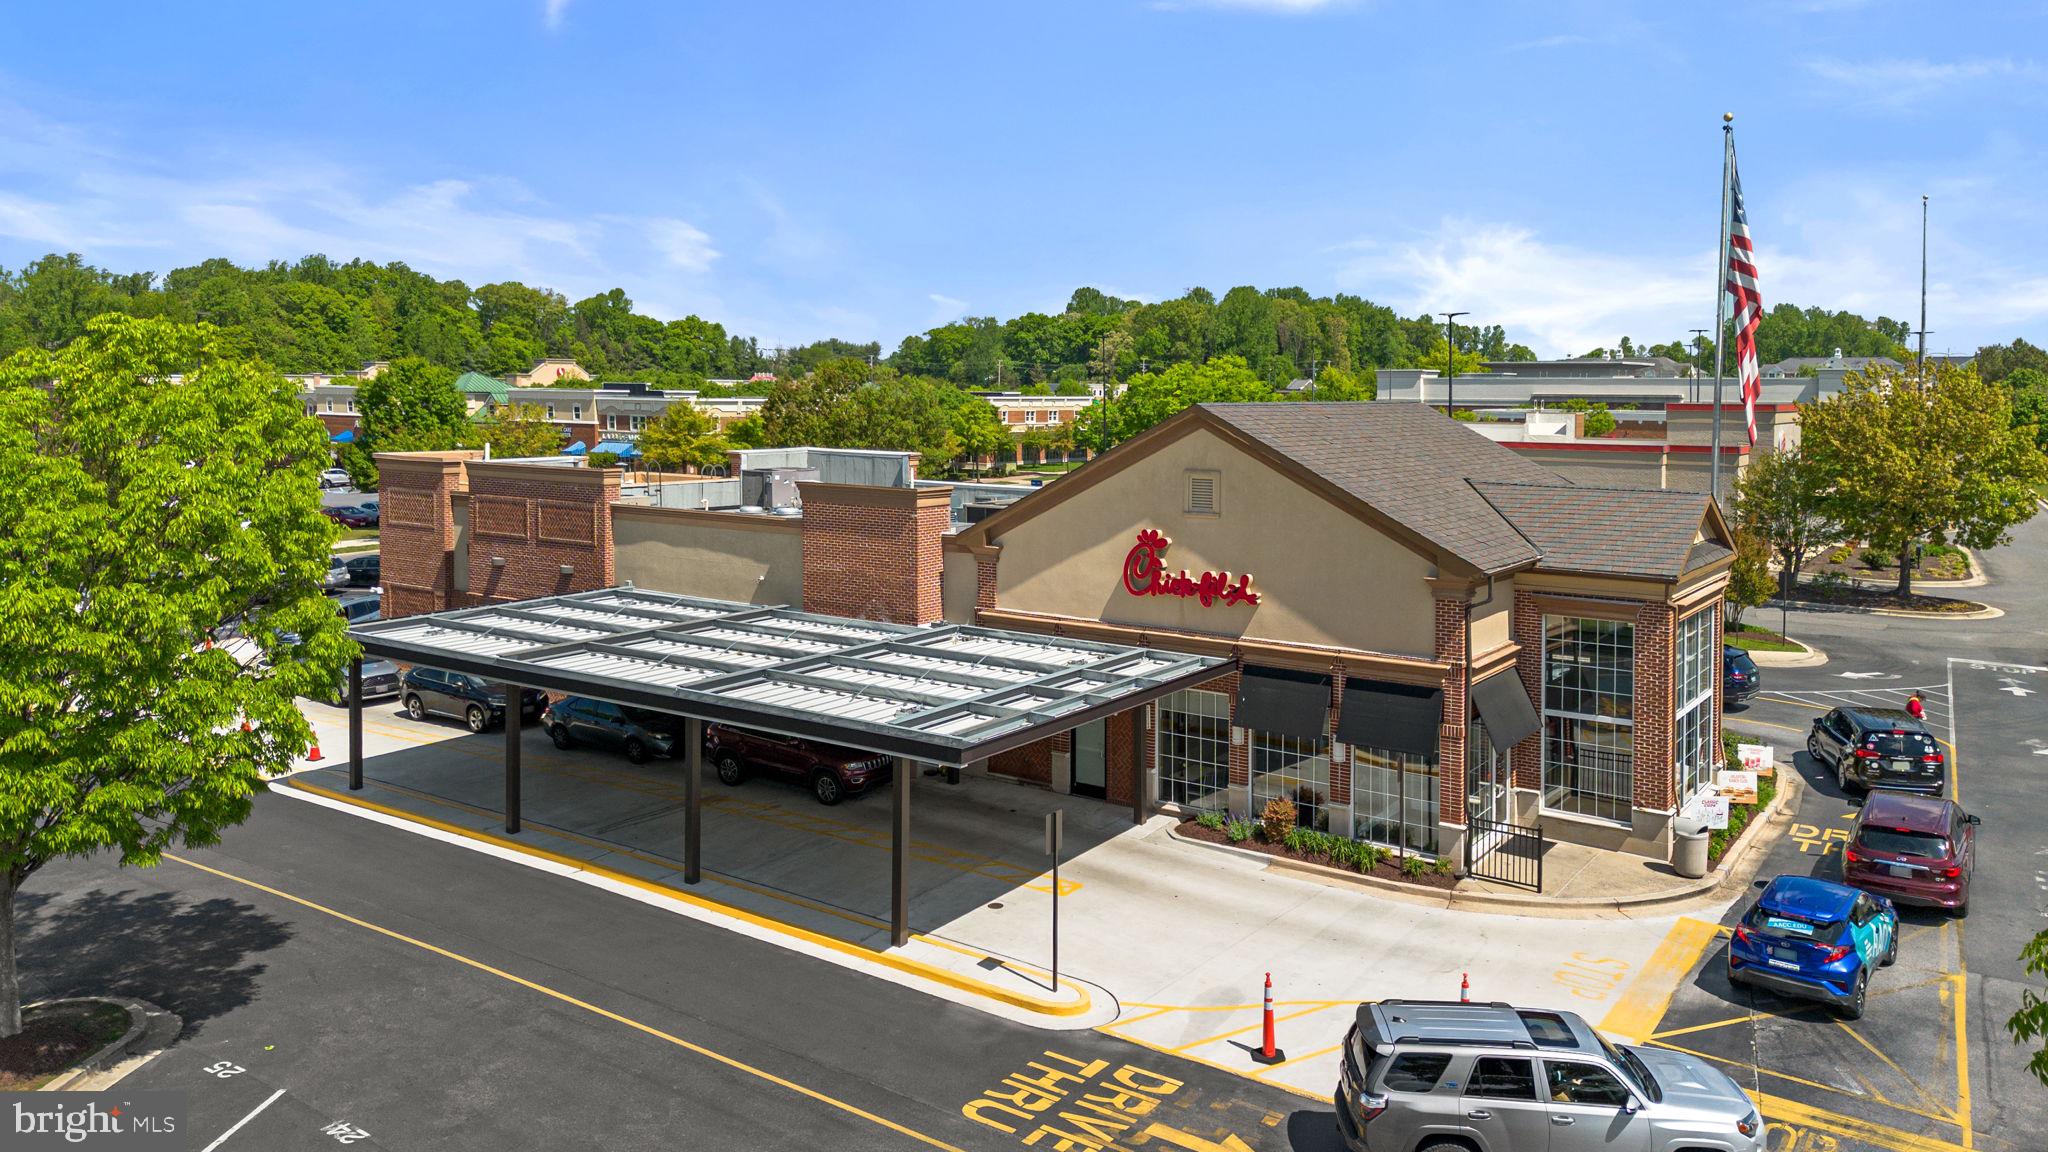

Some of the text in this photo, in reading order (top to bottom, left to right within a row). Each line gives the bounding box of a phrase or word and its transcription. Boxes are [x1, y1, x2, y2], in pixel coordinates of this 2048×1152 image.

[1123, 529, 1261, 608] Chick-fil-A
[202, 1061, 247, 1079] 25
[961, 1050, 1111, 1134] THRU
